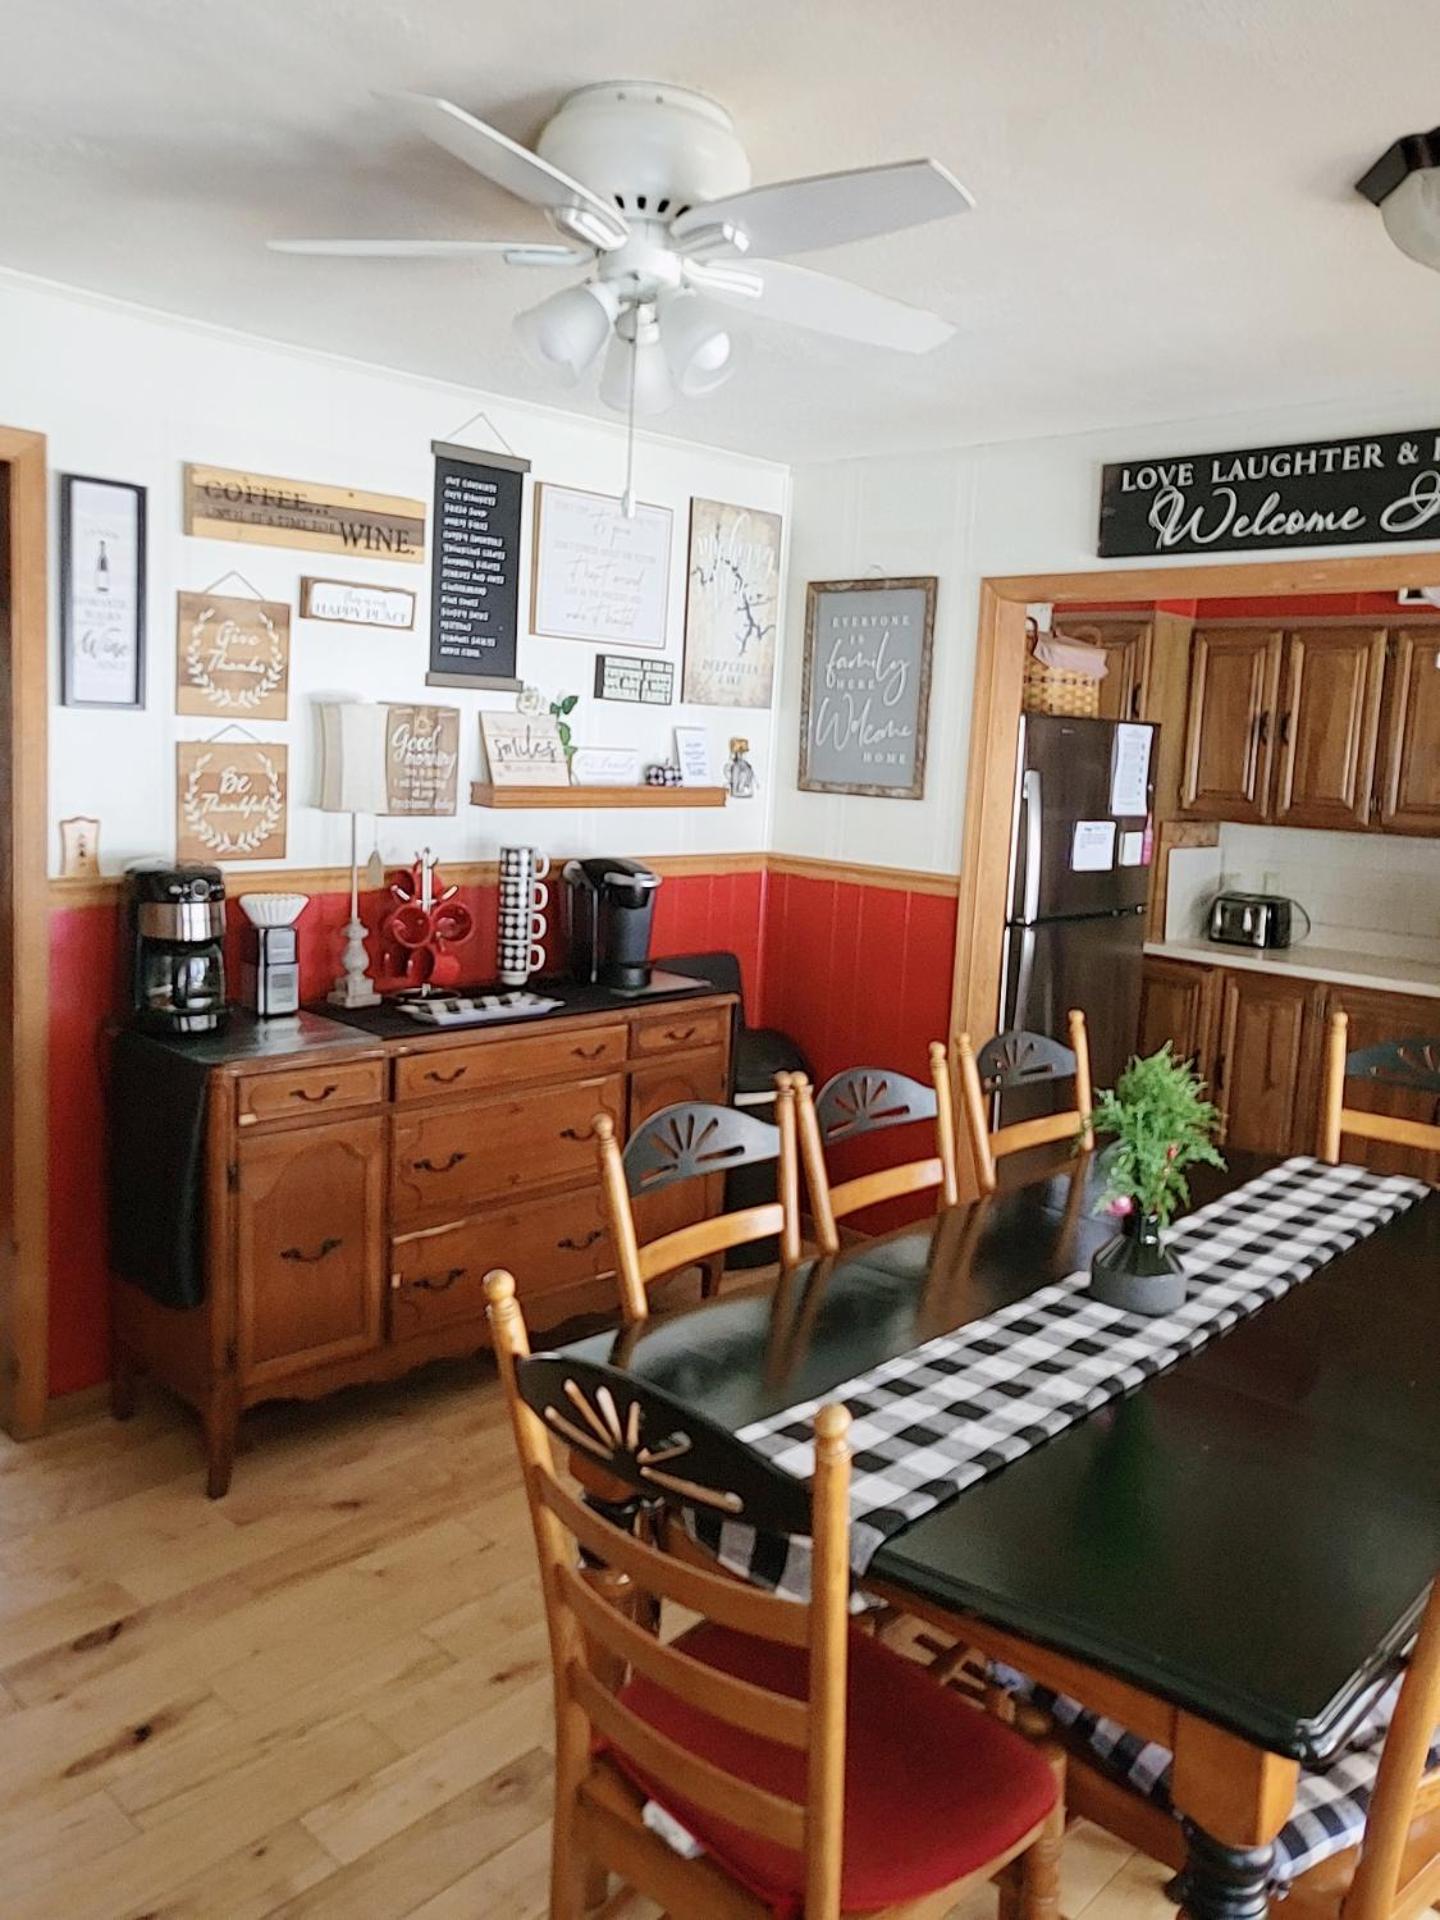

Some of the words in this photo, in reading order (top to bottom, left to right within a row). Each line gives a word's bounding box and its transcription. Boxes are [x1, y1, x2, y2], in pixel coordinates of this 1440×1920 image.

[1121, 463, 1194, 492] LOVE
[1211, 443, 1385, 484] LAUGHTER
[1397, 442, 1419, 465] &
[1148, 487, 1367, 549] Welcome
[832, 615, 911, 629] EVERYONE
[826, 631, 911, 707] family
[391, 723, 442, 763] Good
[862, 752, 907, 765] HOME
[220, 766, 253, 794] Be
